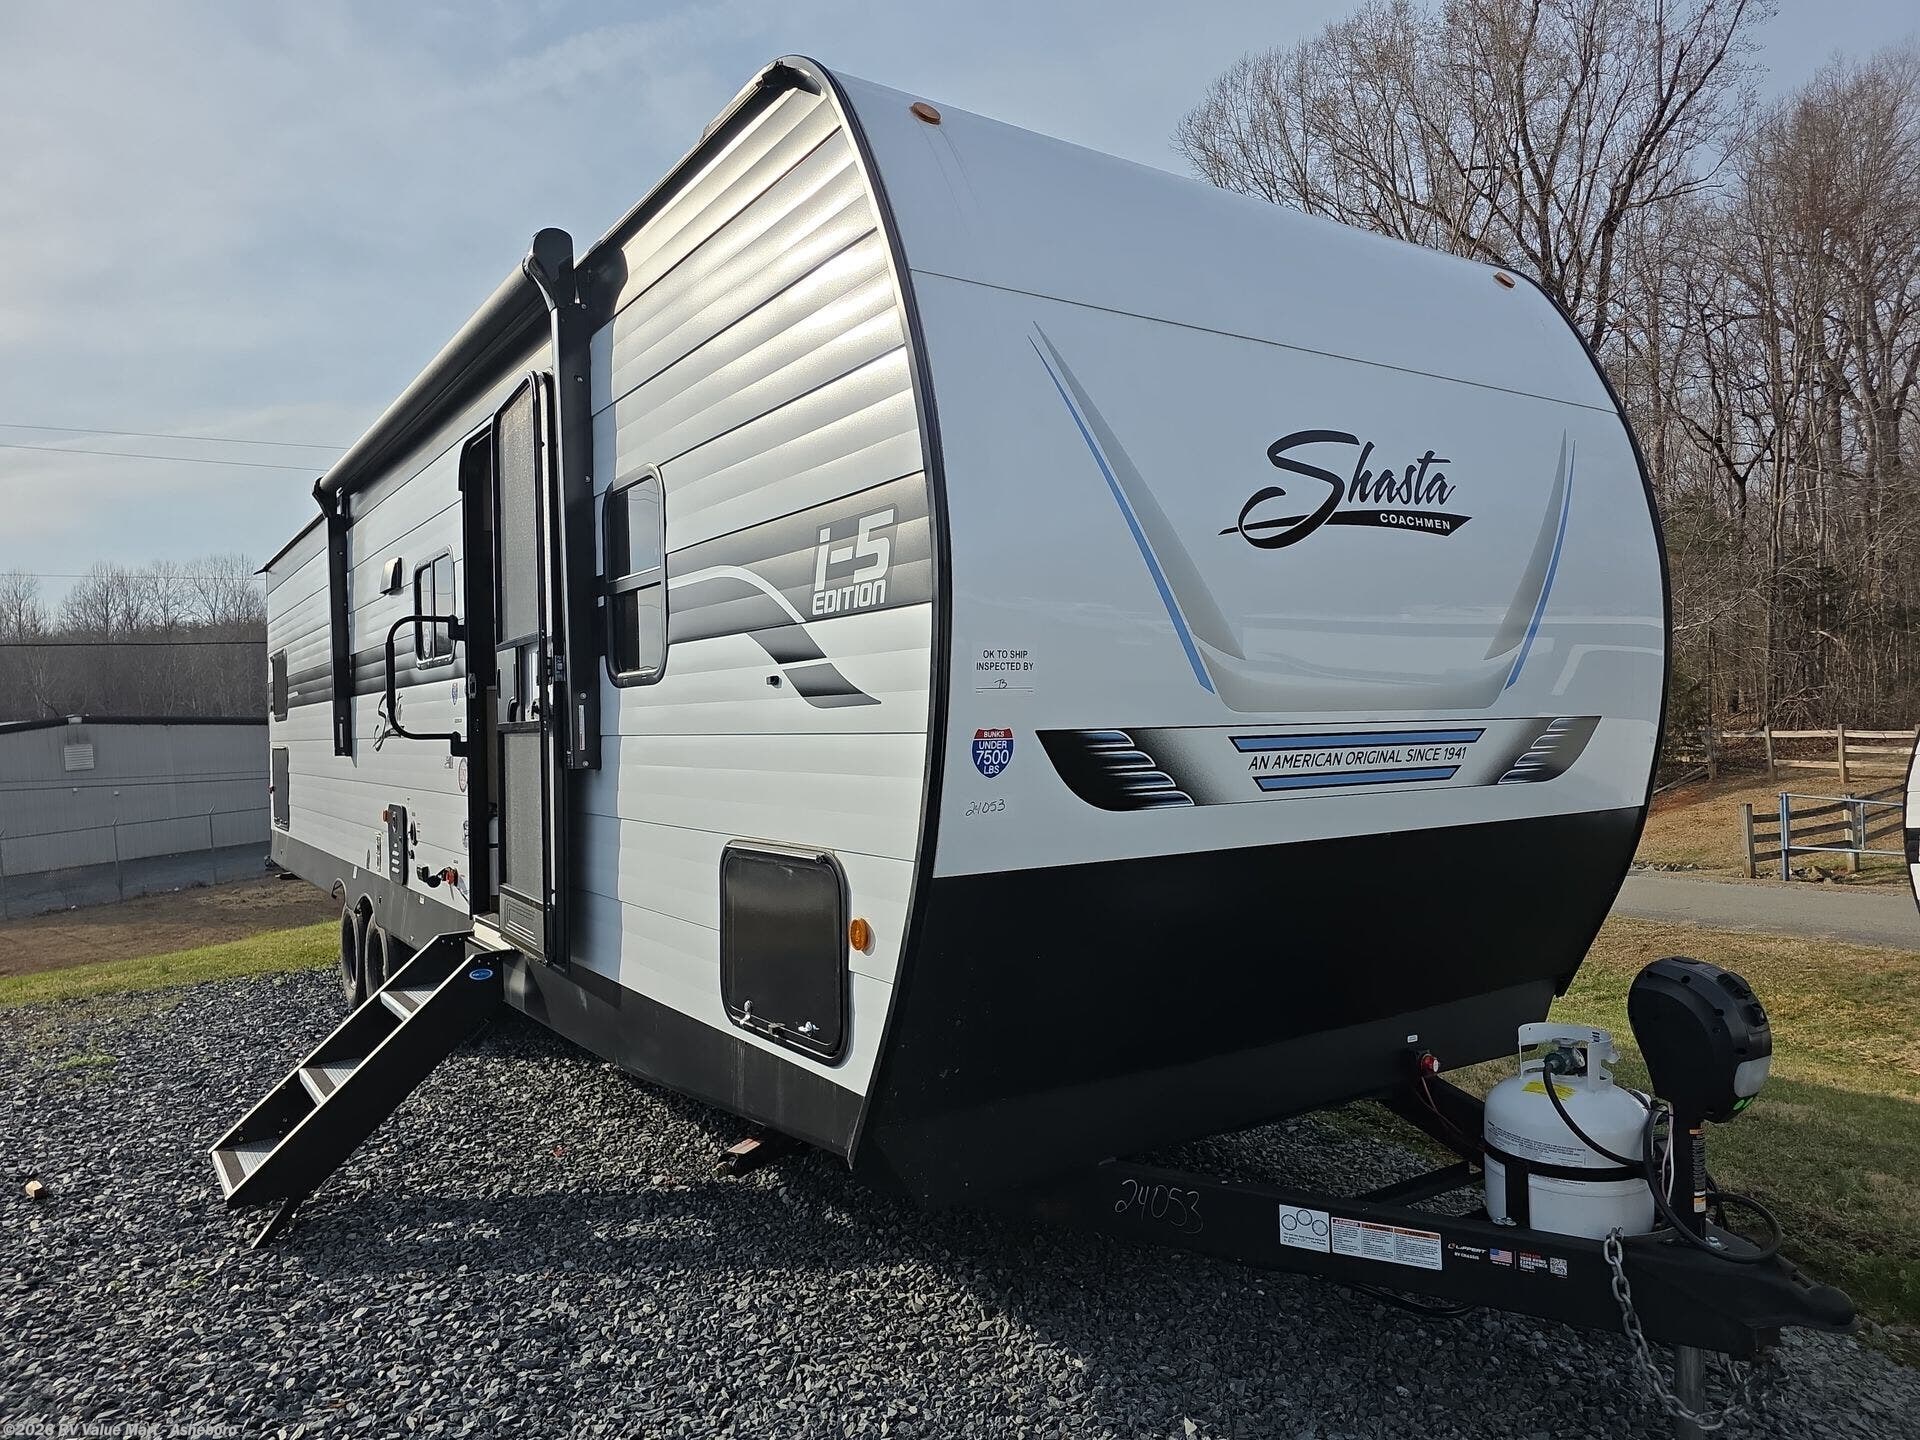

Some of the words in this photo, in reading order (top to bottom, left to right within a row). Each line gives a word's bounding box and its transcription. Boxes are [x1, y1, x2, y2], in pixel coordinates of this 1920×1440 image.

[1238, 430, 1457, 549] Shasta
[1379, 512, 1452, 531] COACHMEN
[814, 508, 895, 592] i-5
[812, 580, 887, 615] EDITION
[983, 650, 995, 659] OK
[998, 650, 1008, 659] TO
[1010, 650, 1028, 659] SHIP
[976, 662, 1021, 671] INSPECTED
[1023, 662, 1034, 671] BY
[978, 740, 1008, 750] UNDER
[976, 750, 1010, 766] 7500
[1248, 756, 1269, 770] AN
[1272, 752, 1342, 769] AMERICAN
[1345, 749, 1403, 767] ORIGINAL
[1405, 747, 1442, 764] SINCE
[1443, 746, 1467, 761] 1941
[983, 765, 1000, 775] LBS
[965, 798, 1006, 817] 24053
[1115, 1179, 1204, 1234] 24053
